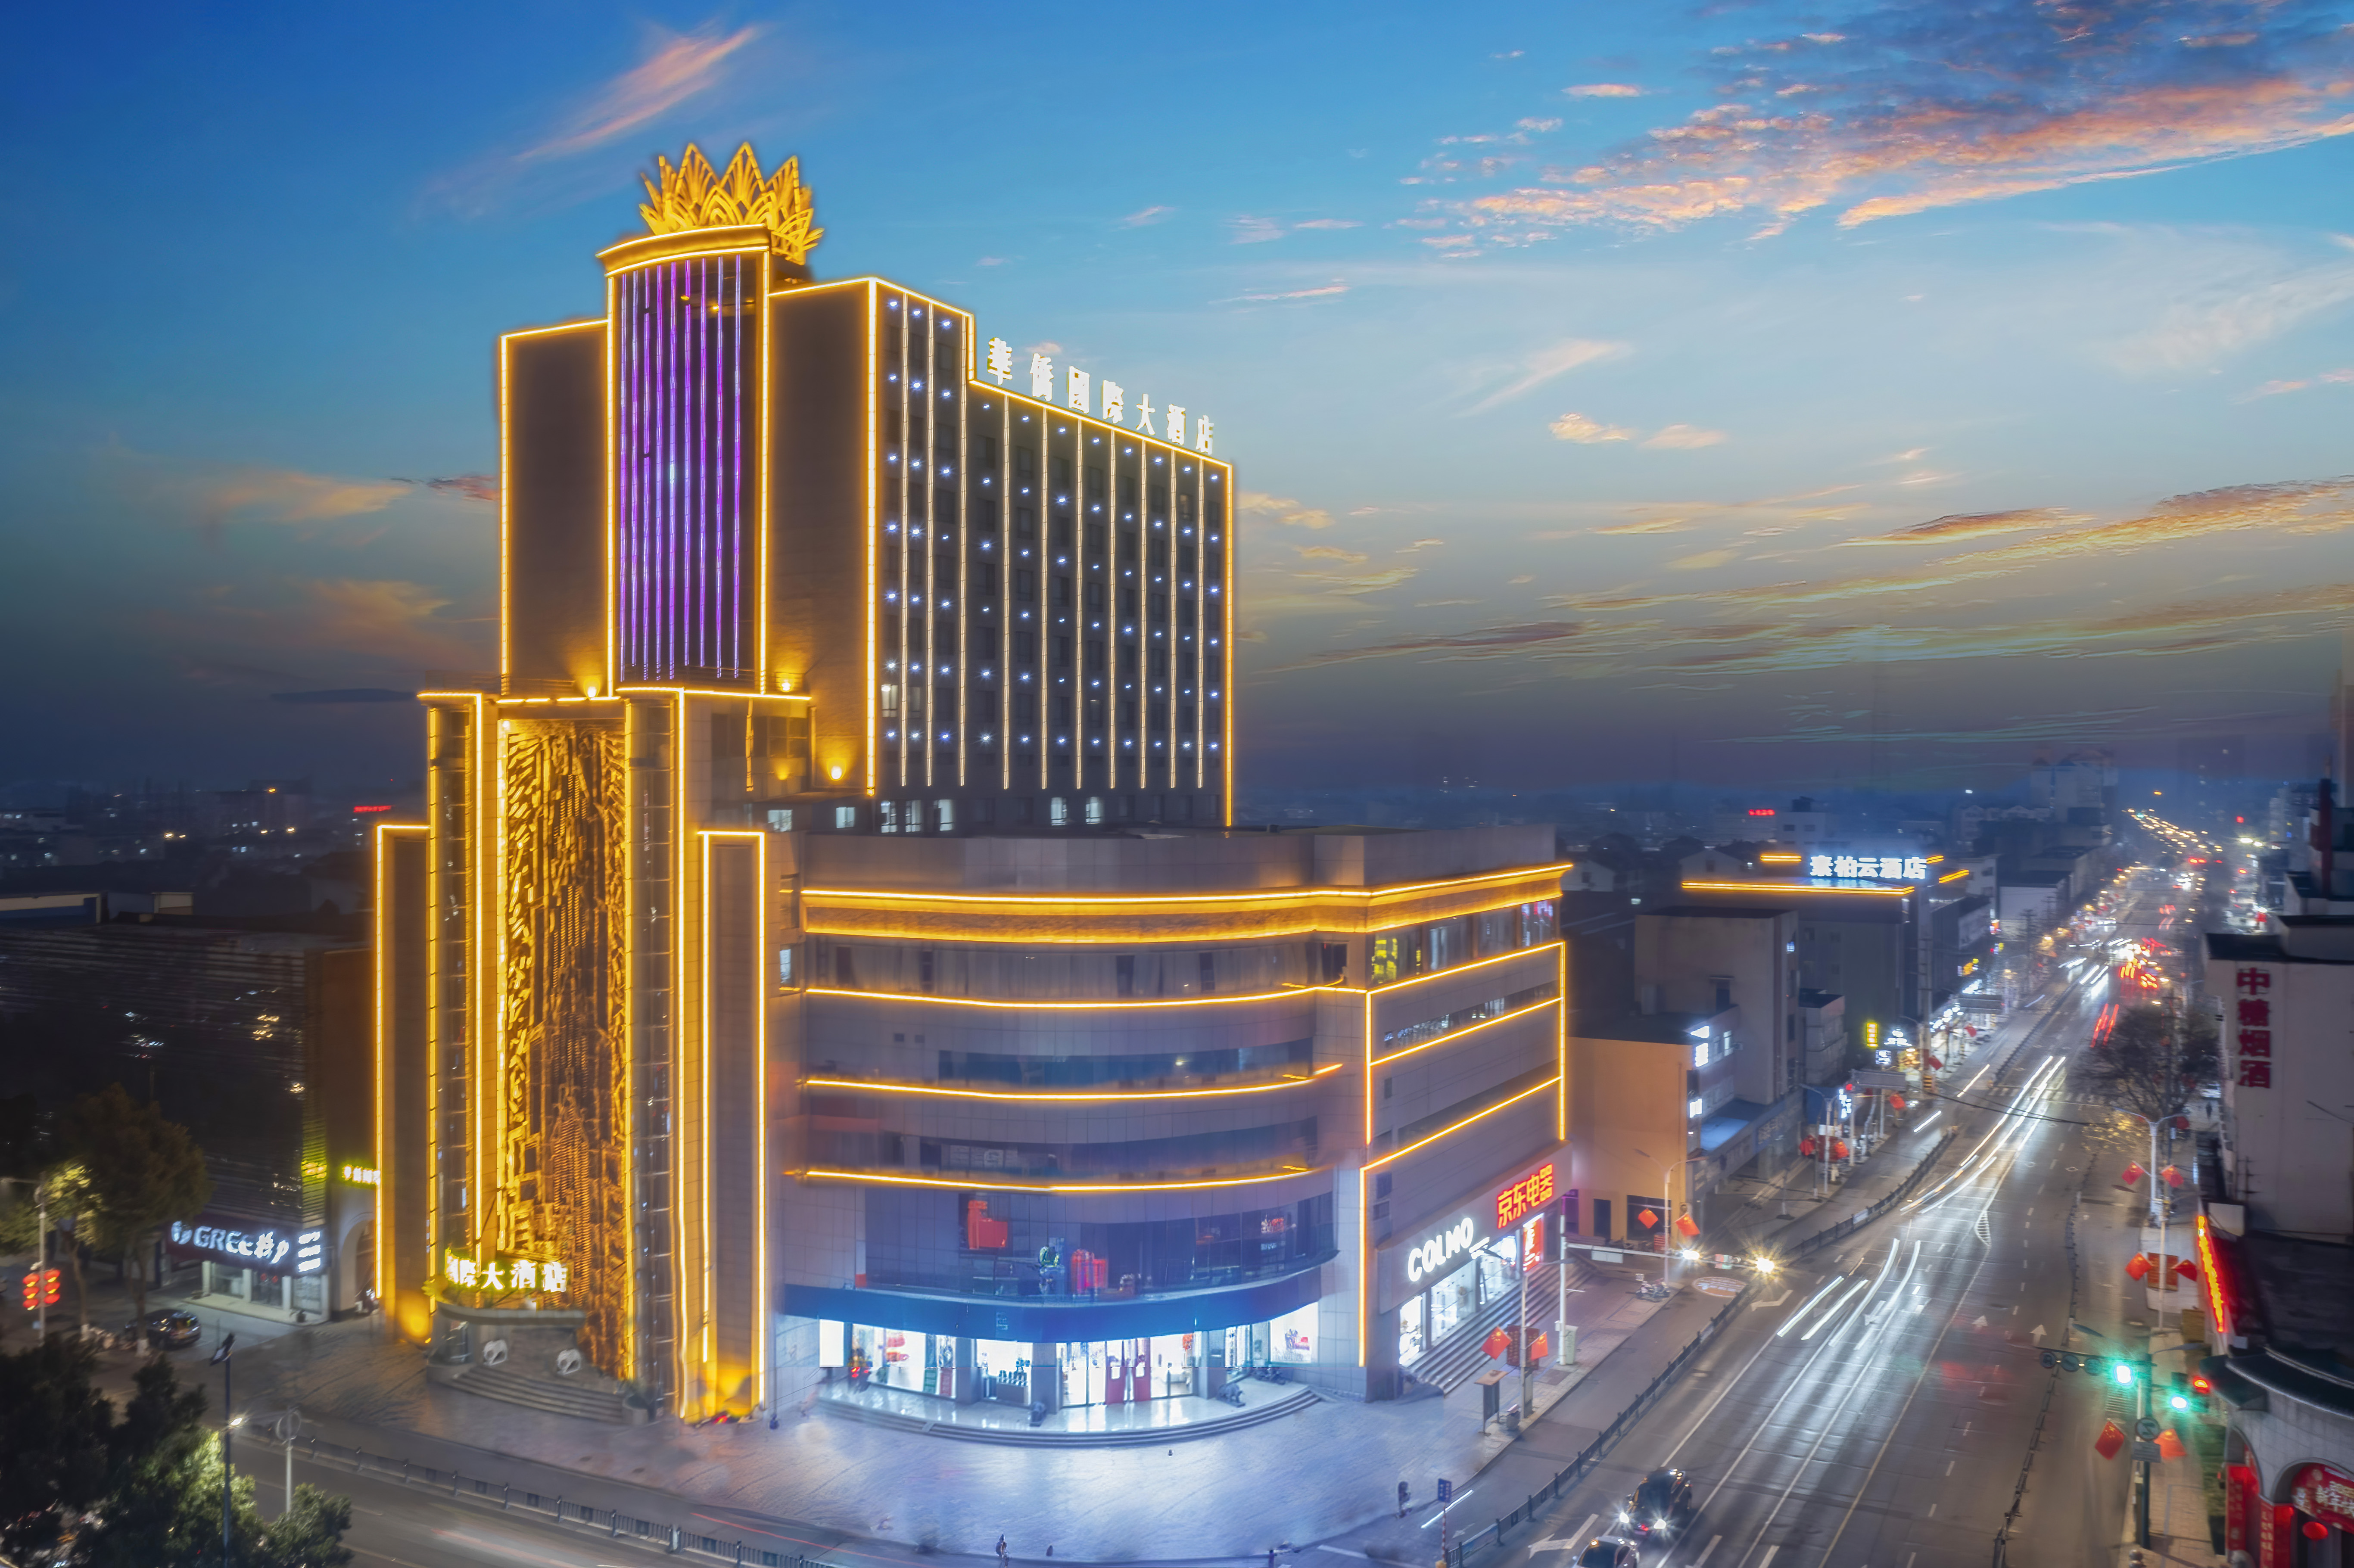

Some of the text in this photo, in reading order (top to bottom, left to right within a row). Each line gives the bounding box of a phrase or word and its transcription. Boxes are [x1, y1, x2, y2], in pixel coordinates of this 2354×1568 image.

[1810, 855, 1927, 879] 素柏云酒店
[1497, 1164, 1554, 1229] 京东电器
[1407, 1218, 1474, 1282] COLMO
